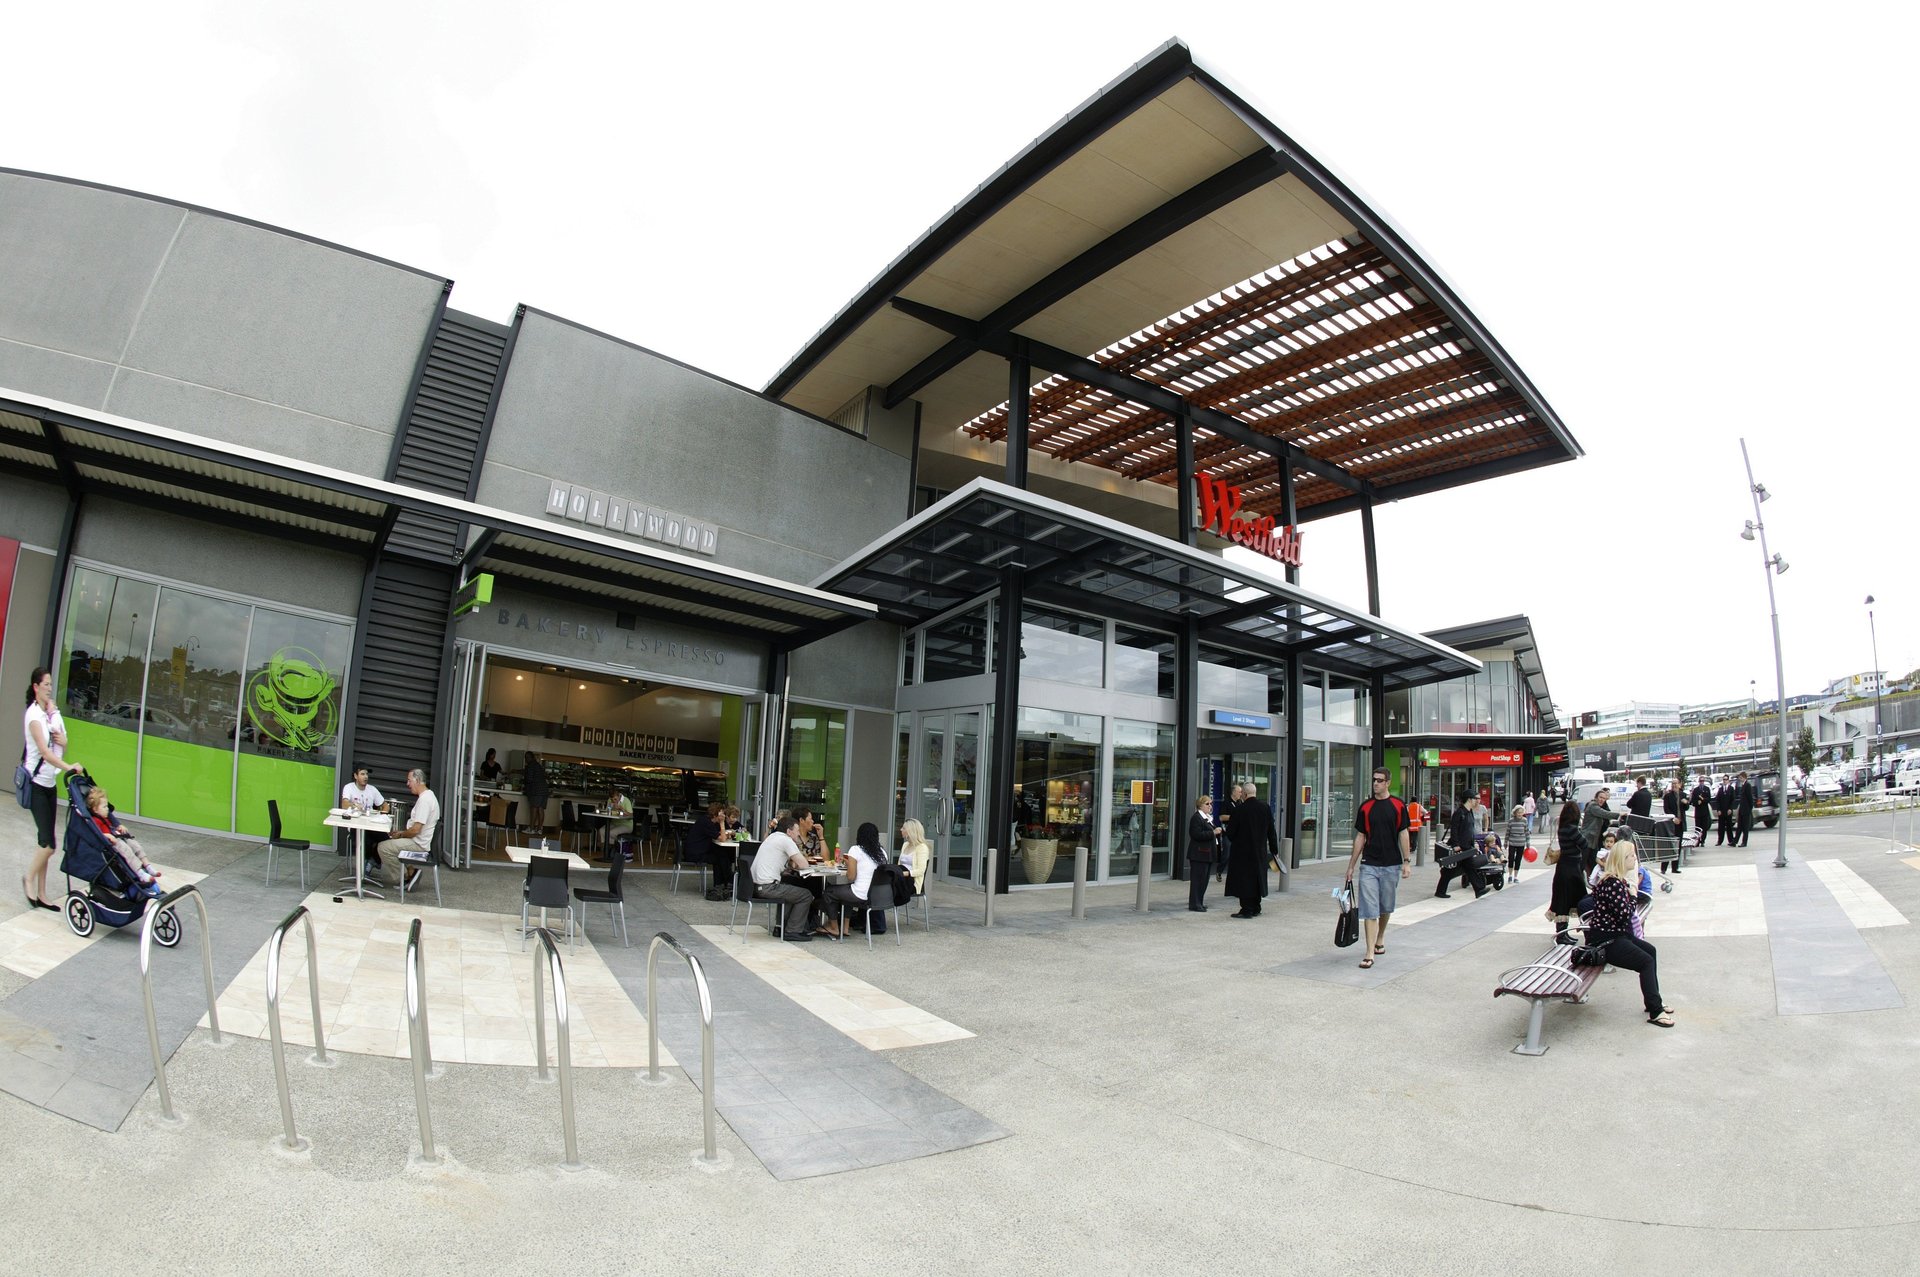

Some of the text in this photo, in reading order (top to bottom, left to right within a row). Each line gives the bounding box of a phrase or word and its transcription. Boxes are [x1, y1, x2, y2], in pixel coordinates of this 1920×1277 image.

[552, 489, 715, 548] HOLLYWOOD
[1194, 472, 1304, 567] Westfield
[498, 608, 725, 666] BAKERY ESPRESSO
[585, 730, 674, 750] HOLLYWOOD
[620, 750, 675, 762] BAKERY ESPRESSO
[1490, 754, 1512, 762] PostShop
